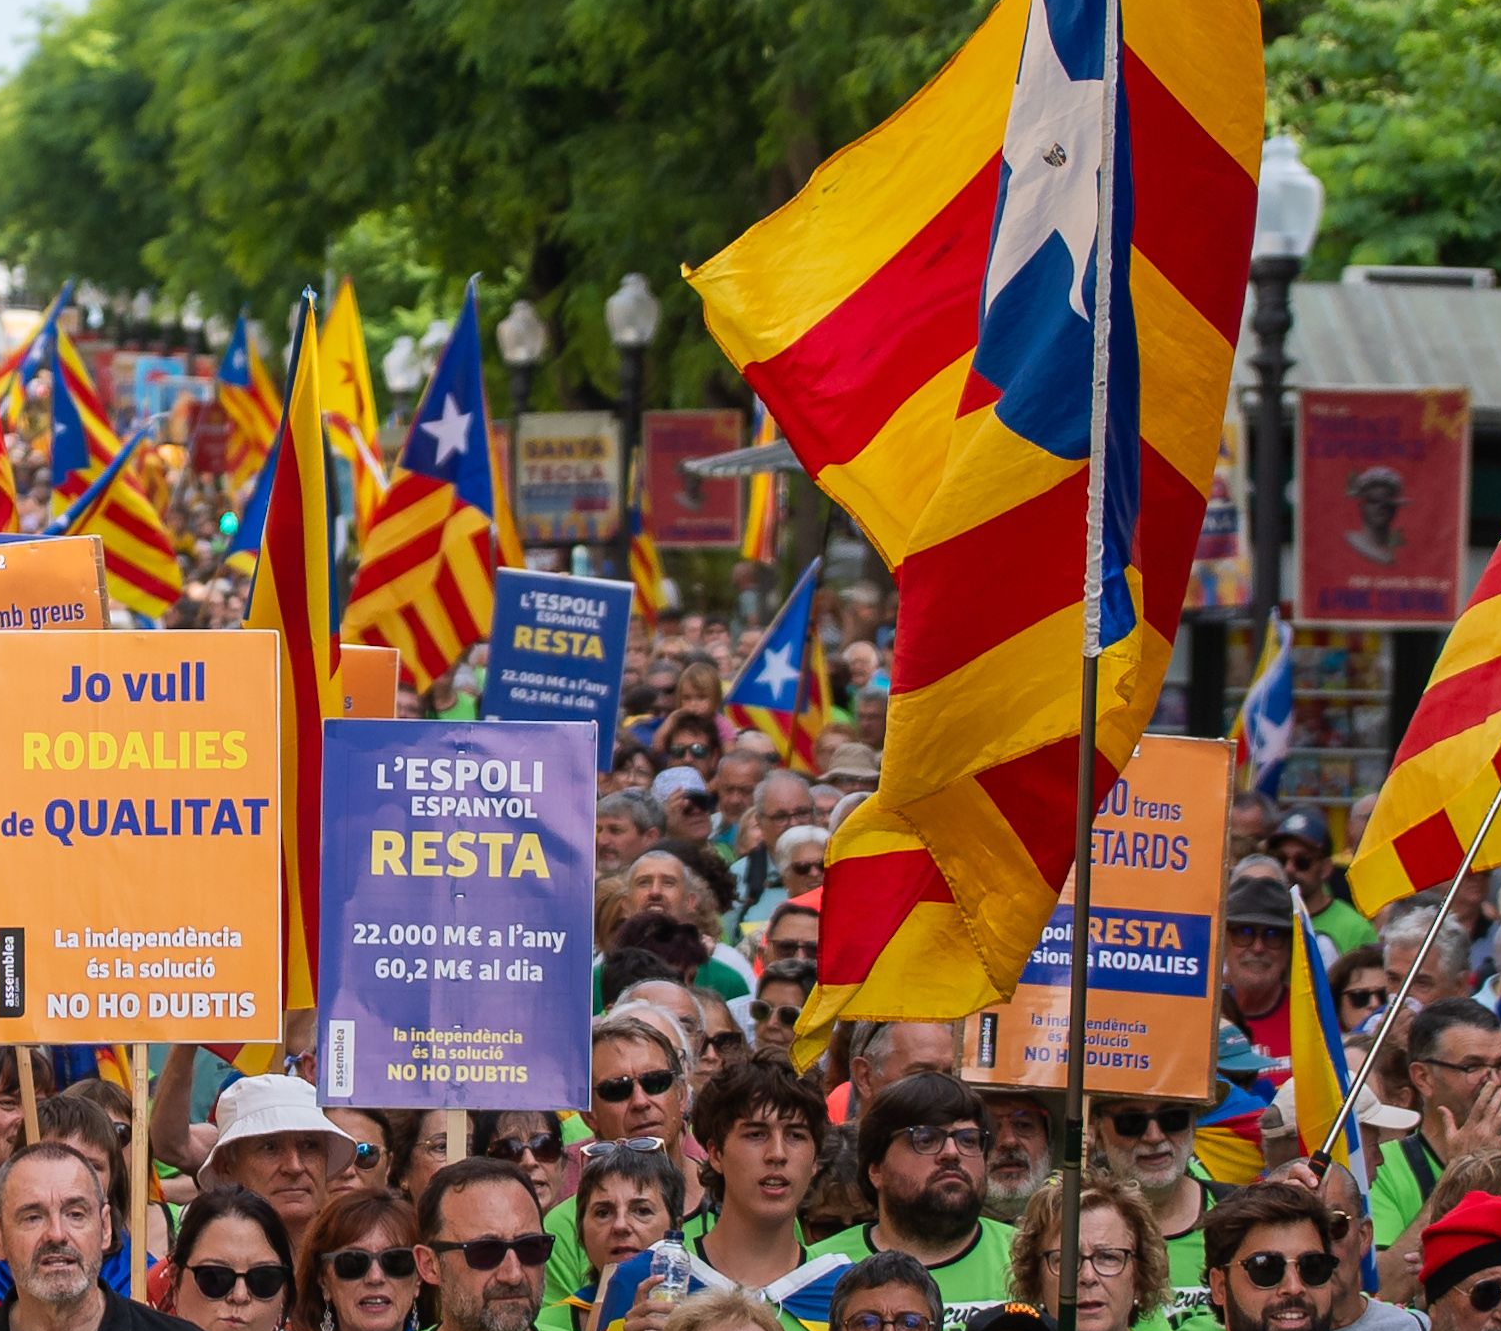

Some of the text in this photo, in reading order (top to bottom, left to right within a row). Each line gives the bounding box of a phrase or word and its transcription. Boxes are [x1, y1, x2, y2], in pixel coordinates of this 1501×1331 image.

[30, 602, 85, 629] greus
[520, 591, 606, 617] L'ESPOLI
[536, 611, 600, 629] ESPANYOL
[513, 626, 604, 659] RESTA
[62, 662, 206, 703] Jo vull
[501, 669, 608, 695] 22.000 M€ l'any
[510, 686, 594, 709] 60,2 M€ dia
[23, 730, 248, 770] RODALIES
[376, 756, 544, 794] L'ESPOLI
[411, 796, 538, 819] ESPANYOL
[1133, 796, 1182, 821] trens
[1, 799, 270, 847] de QUALITAT
[370, 830, 551, 879] RESTA
[1090, 827, 1190, 871] ETARDS
[55, 926, 242, 952] La independència
[353, 923, 567, 953] 22.000 M€ a l'any
[1088, 916, 1182, 951] RESTA
[4, 935, 15, 1008] assemblea
[86, 957, 216, 979] és la solució
[375, 958, 543, 983] 60,2 M€ al dia
[1098, 951, 1199, 976] RODALIES
[46, 993, 256, 1019] NO HO DUBTIS
[393, 1026, 523, 1046] la independència
[335, 1027, 346, 1088] assemblea
[412, 1044, 504, 1061] és la solució
[1024, 1046, 1149, 1070] NO DUBTIS
[388, 1064, 529, 1084] NO HO DUBTIS
